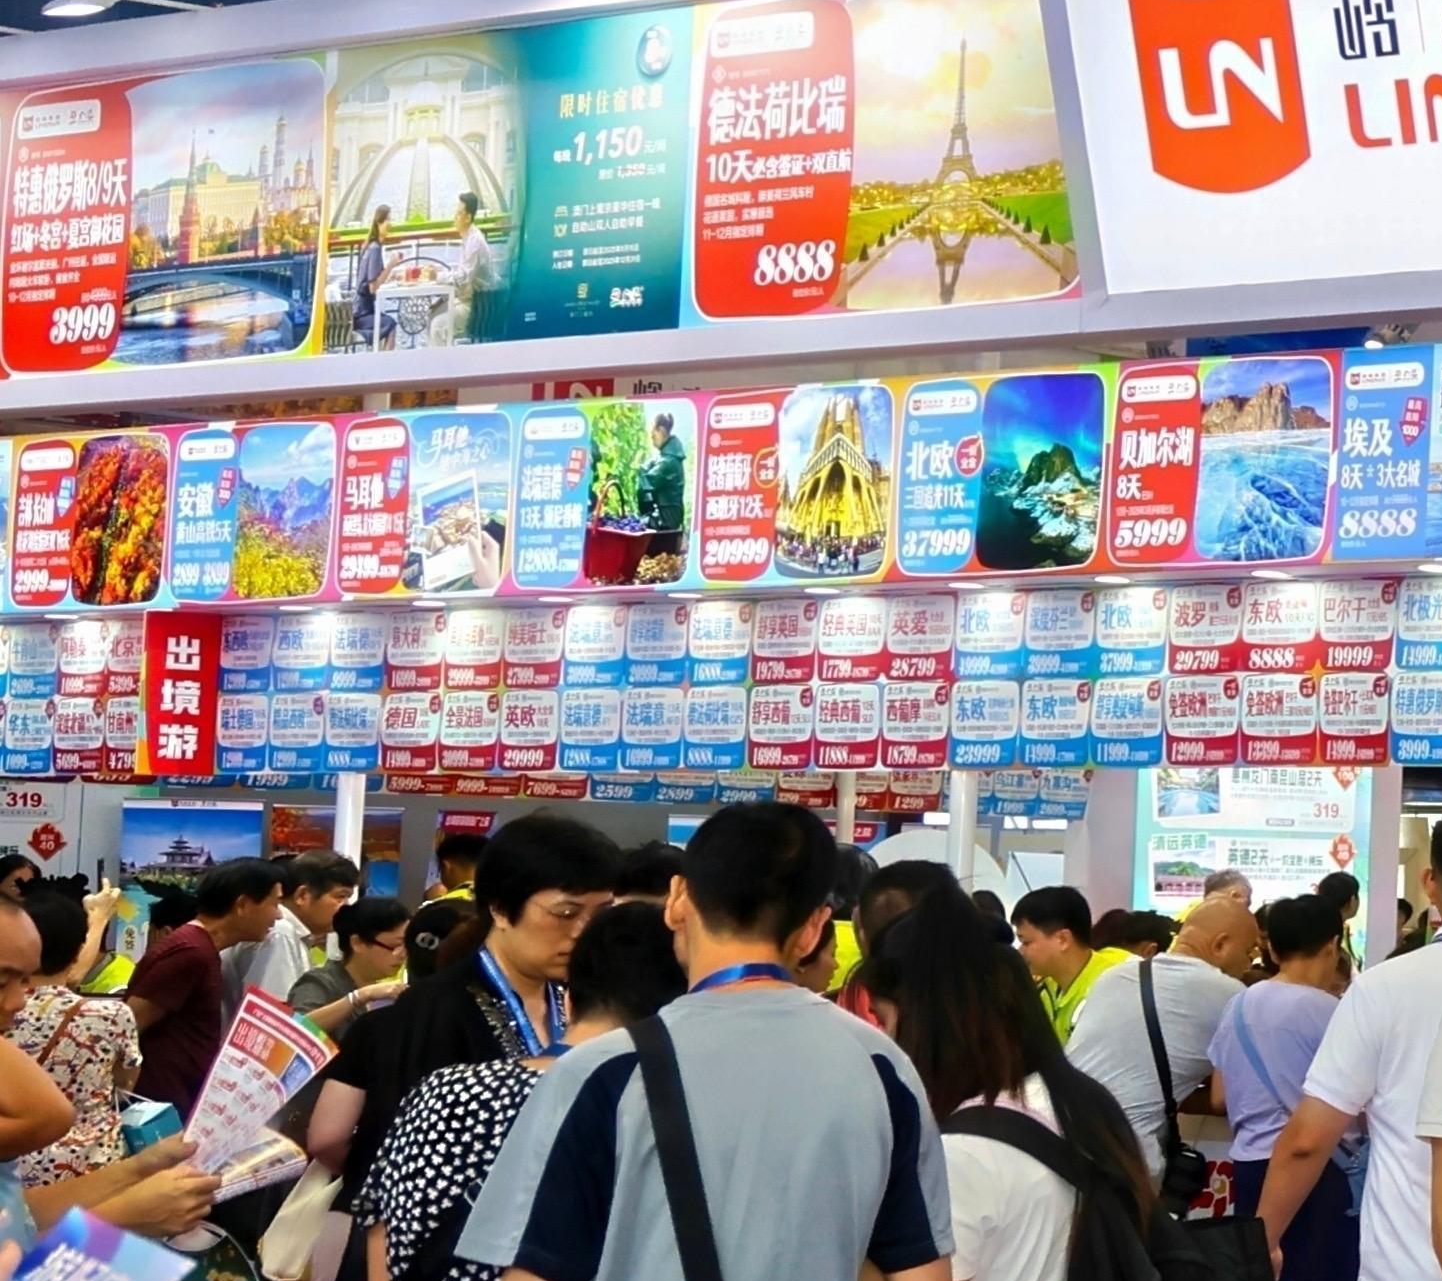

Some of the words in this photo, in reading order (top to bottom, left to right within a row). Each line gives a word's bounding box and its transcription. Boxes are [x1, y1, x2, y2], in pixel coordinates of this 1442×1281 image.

[707, 74, 847, 146] 德法荷比瑞
[573, 125, 643, 166] 1,150
[13, 158, 127, 217] 特惠俄罗斯8/9天
[754, 239, 836, 286] 8888
[50, 303, 116, 346] 3999
[1119, 425, 1195, 470] 贝加尔湖
[1342, 418, 1394, 458] 埃及
[904, 440, 954, 483] 北欧
[176, 482, 214, 518] 安徽
[344, 475, 384, 509] 马耳他
[902, 529, 972, 559] 37999
[1114, 517, 1187, 549] 5999
[1338, 508, 1418, 540] 8888
[702, 536, 768, 566] 20999
[157, 634, 202, 761] 出境游
[385, 705, 417, 730] 德国
[5, 792, 43, 808] 319
